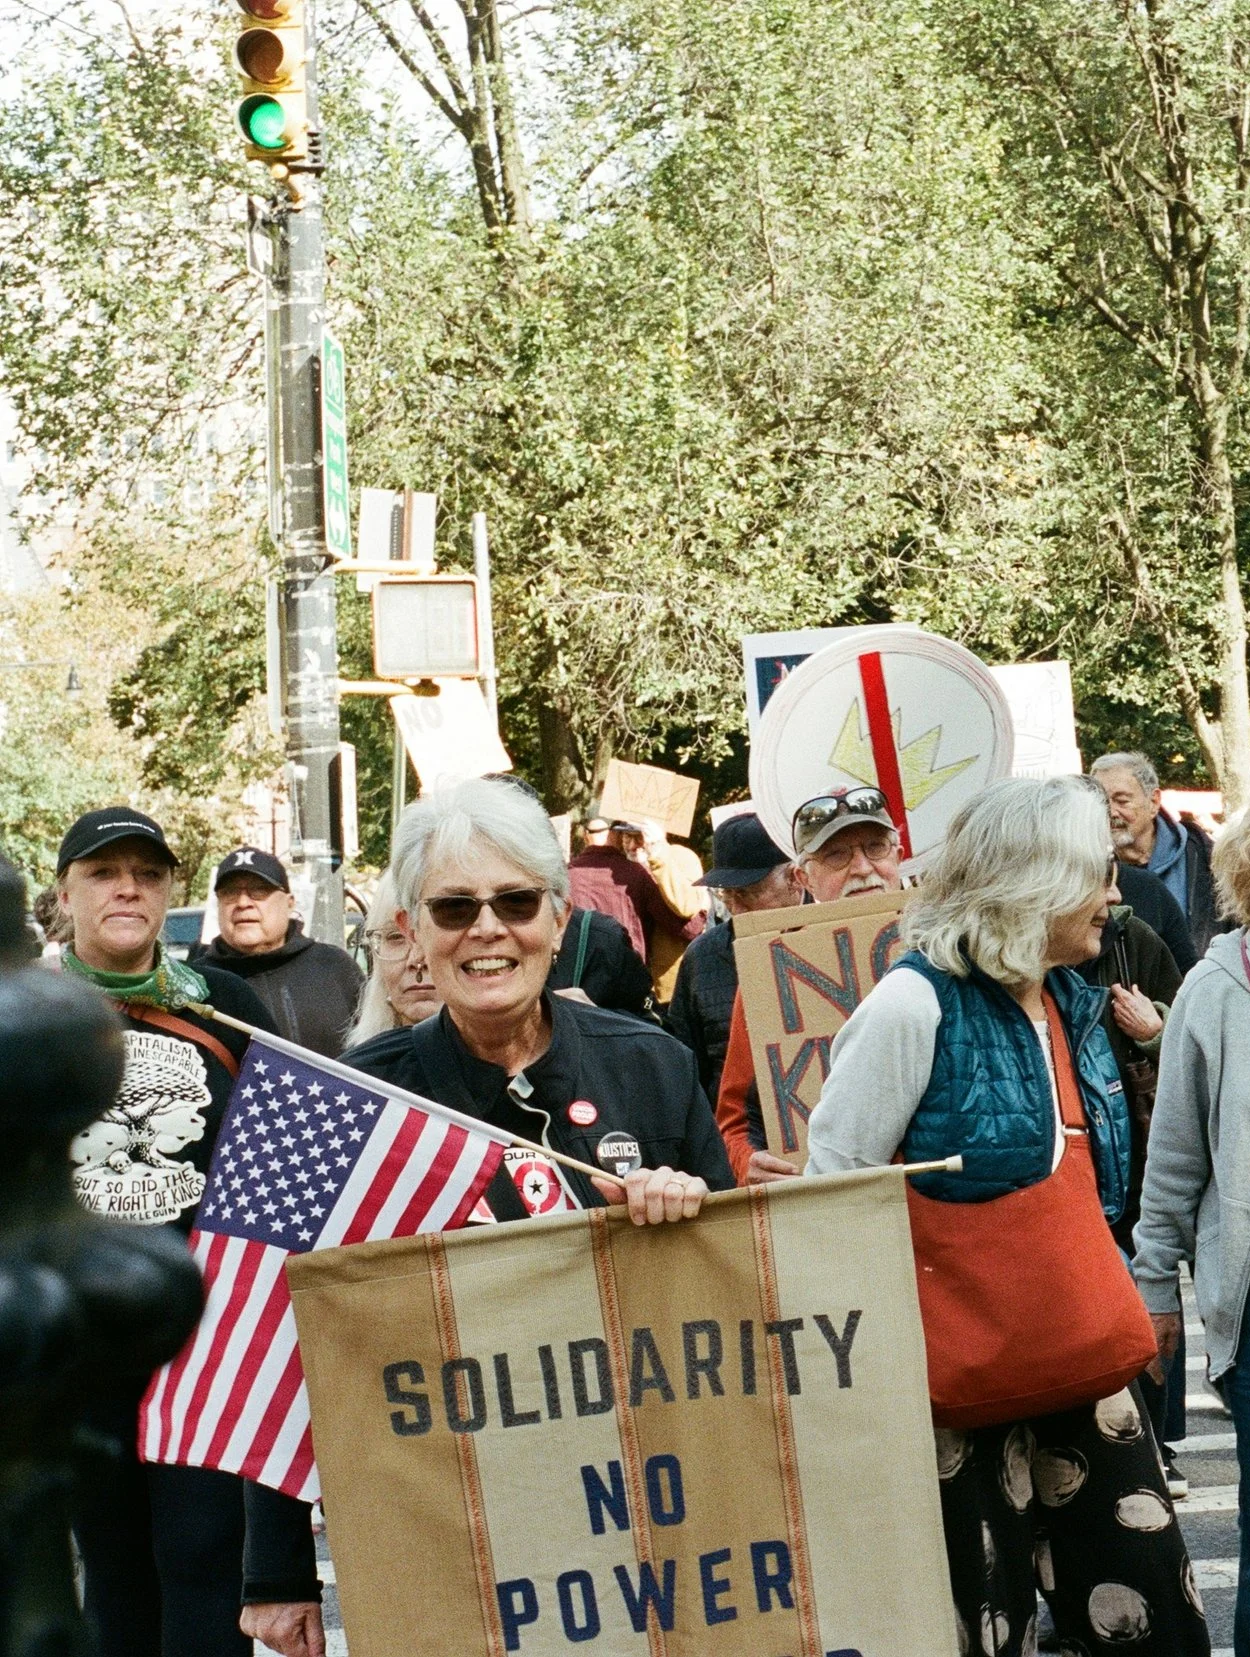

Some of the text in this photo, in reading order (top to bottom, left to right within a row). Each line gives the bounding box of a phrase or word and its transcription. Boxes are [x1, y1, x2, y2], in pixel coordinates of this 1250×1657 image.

[123, 1034, 192, 1060] APITALISM
[75, 1169, 194, 1194] BUT SO DID THE
[107, 1194, 149, 1212] RIGHT
[154, 1191, 168, 1208] OF
[171, 1179, 206, 1205] KINGS
[382, 1310, 863, 1437] SOLIDARITY
[580, 1453, 686, 1535] NO
[496, 1540, 796, 1651] POWER
